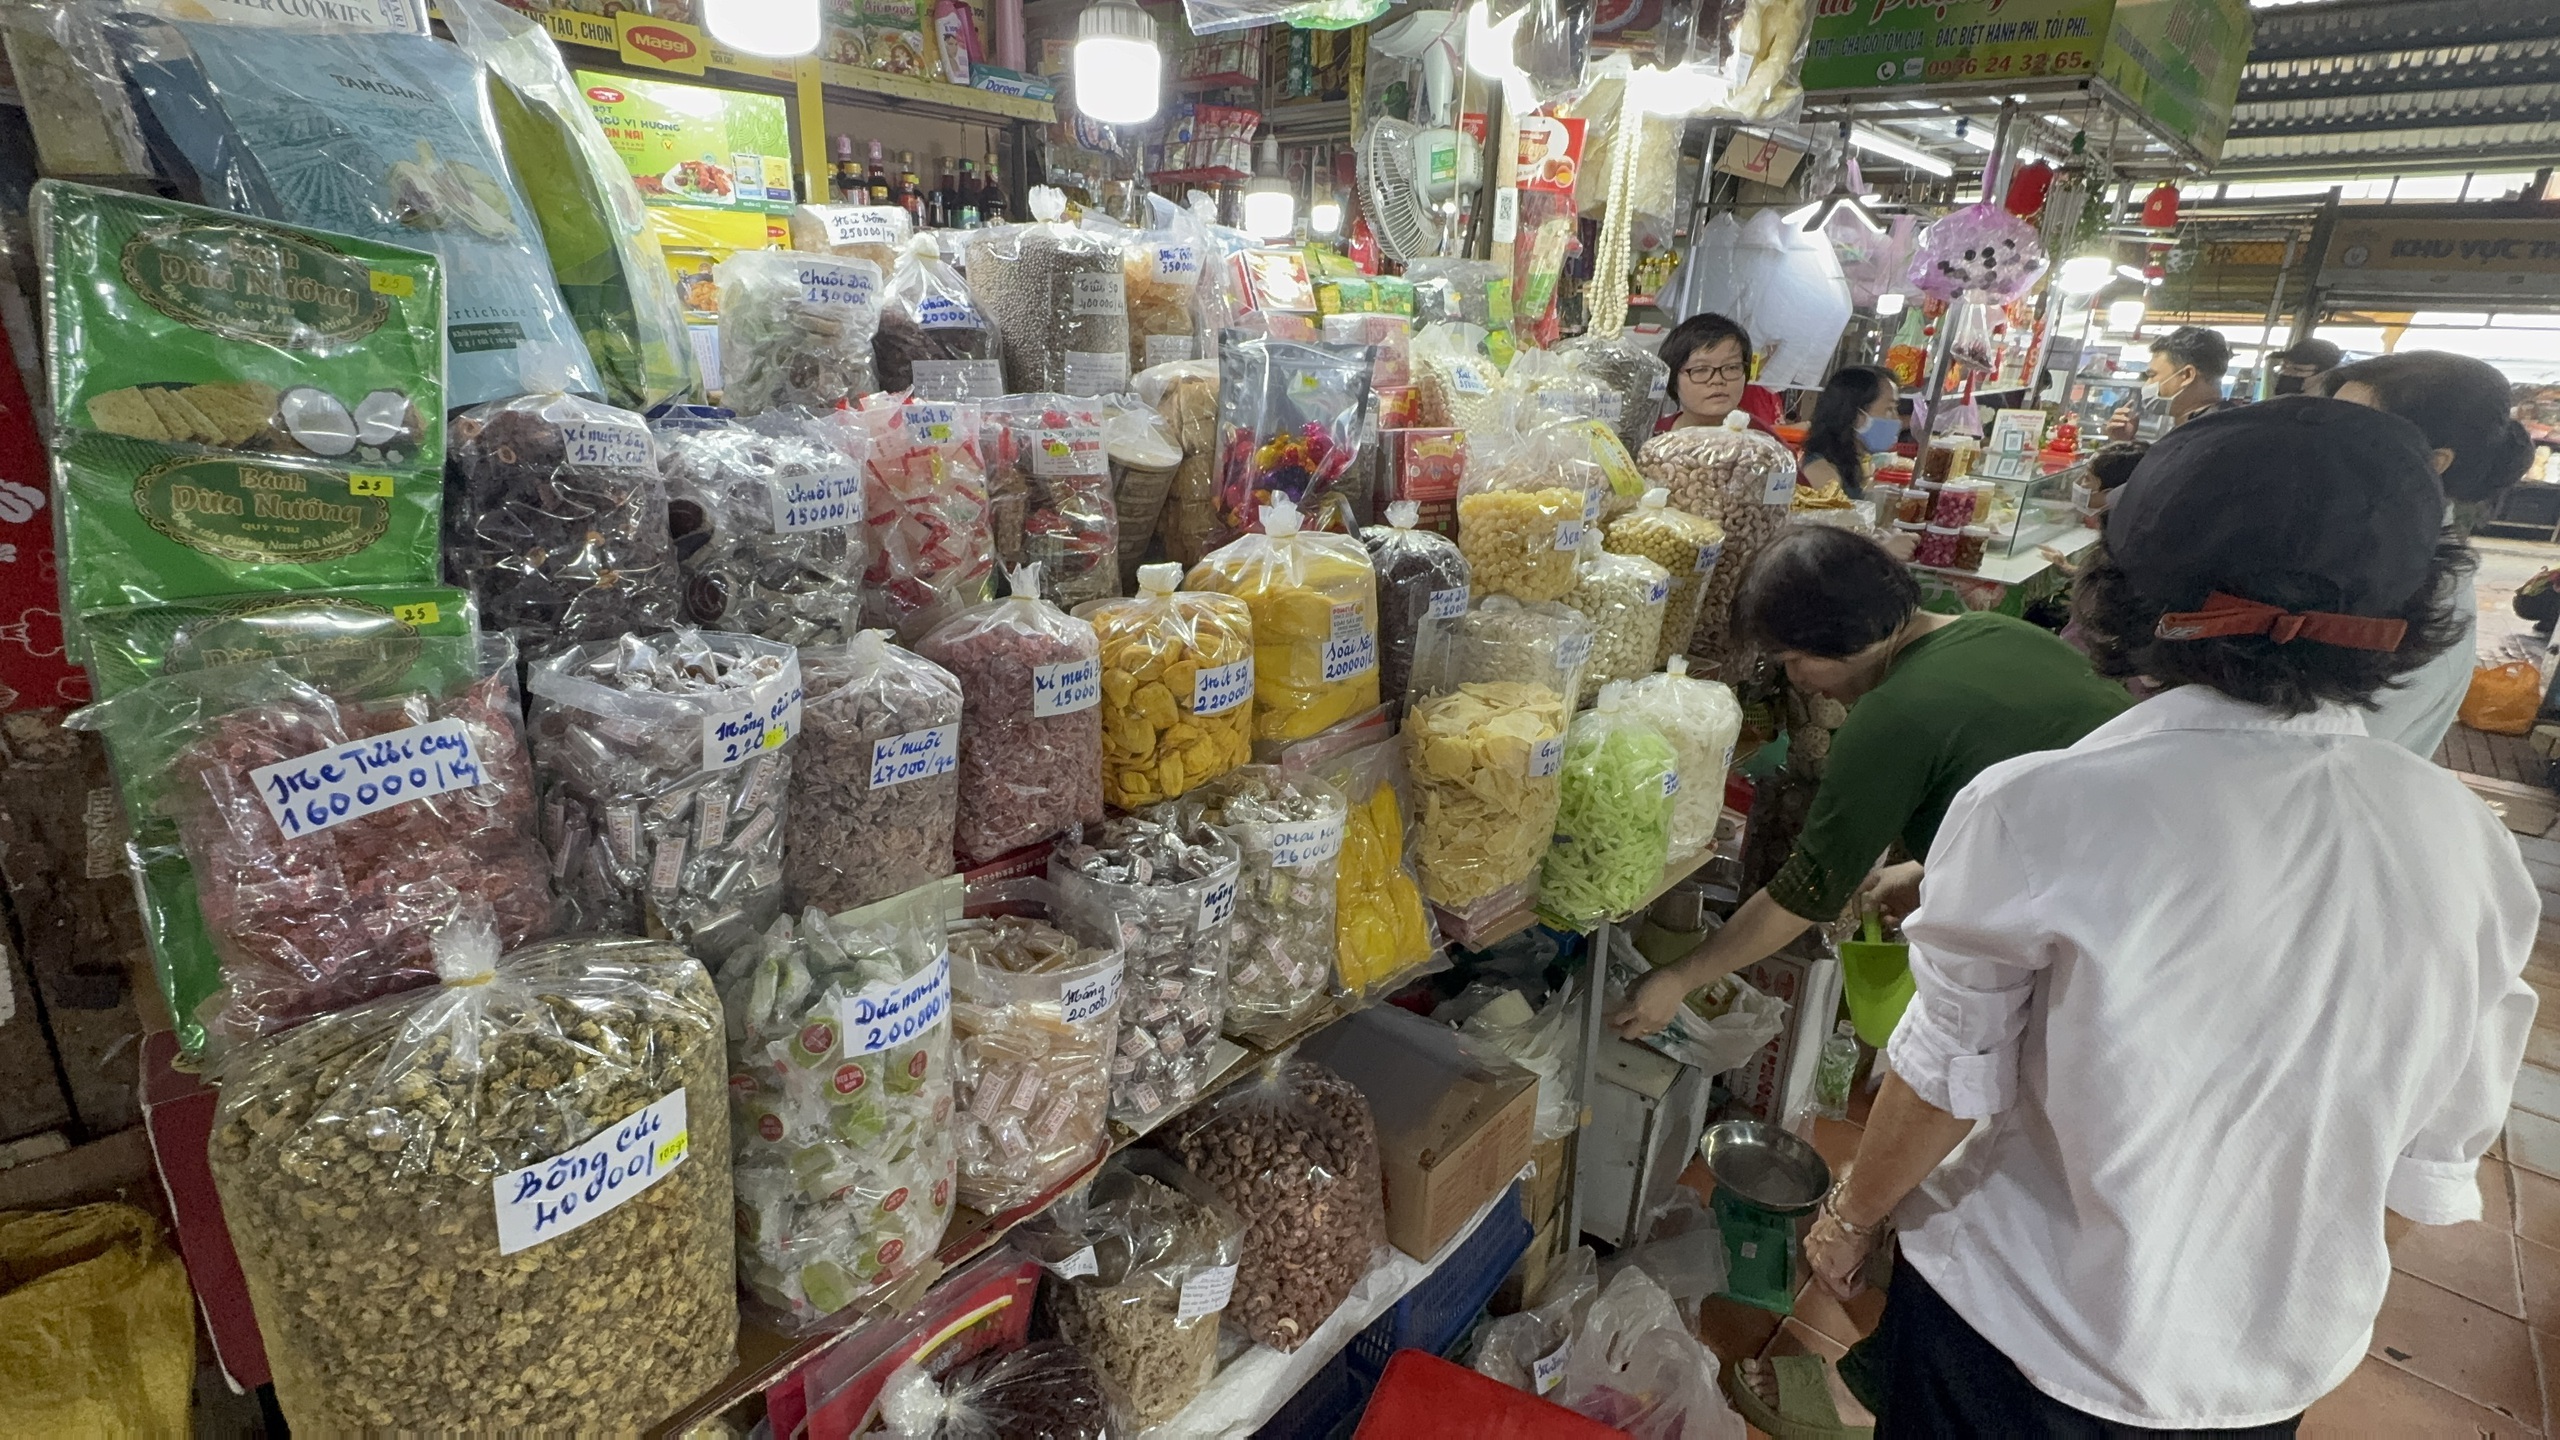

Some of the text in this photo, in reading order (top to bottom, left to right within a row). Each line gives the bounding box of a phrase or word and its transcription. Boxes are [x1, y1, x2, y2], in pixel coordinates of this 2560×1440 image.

[635, 33, 688, 54] Maggi
[1985, 55, 2011, 73] 24
[987, 78, 1020, 96] Doreen
[239, 466, 382, 492] Bánh 25
[403, 606, 426, 622] 25
[420, 731, 469, 757] cay
